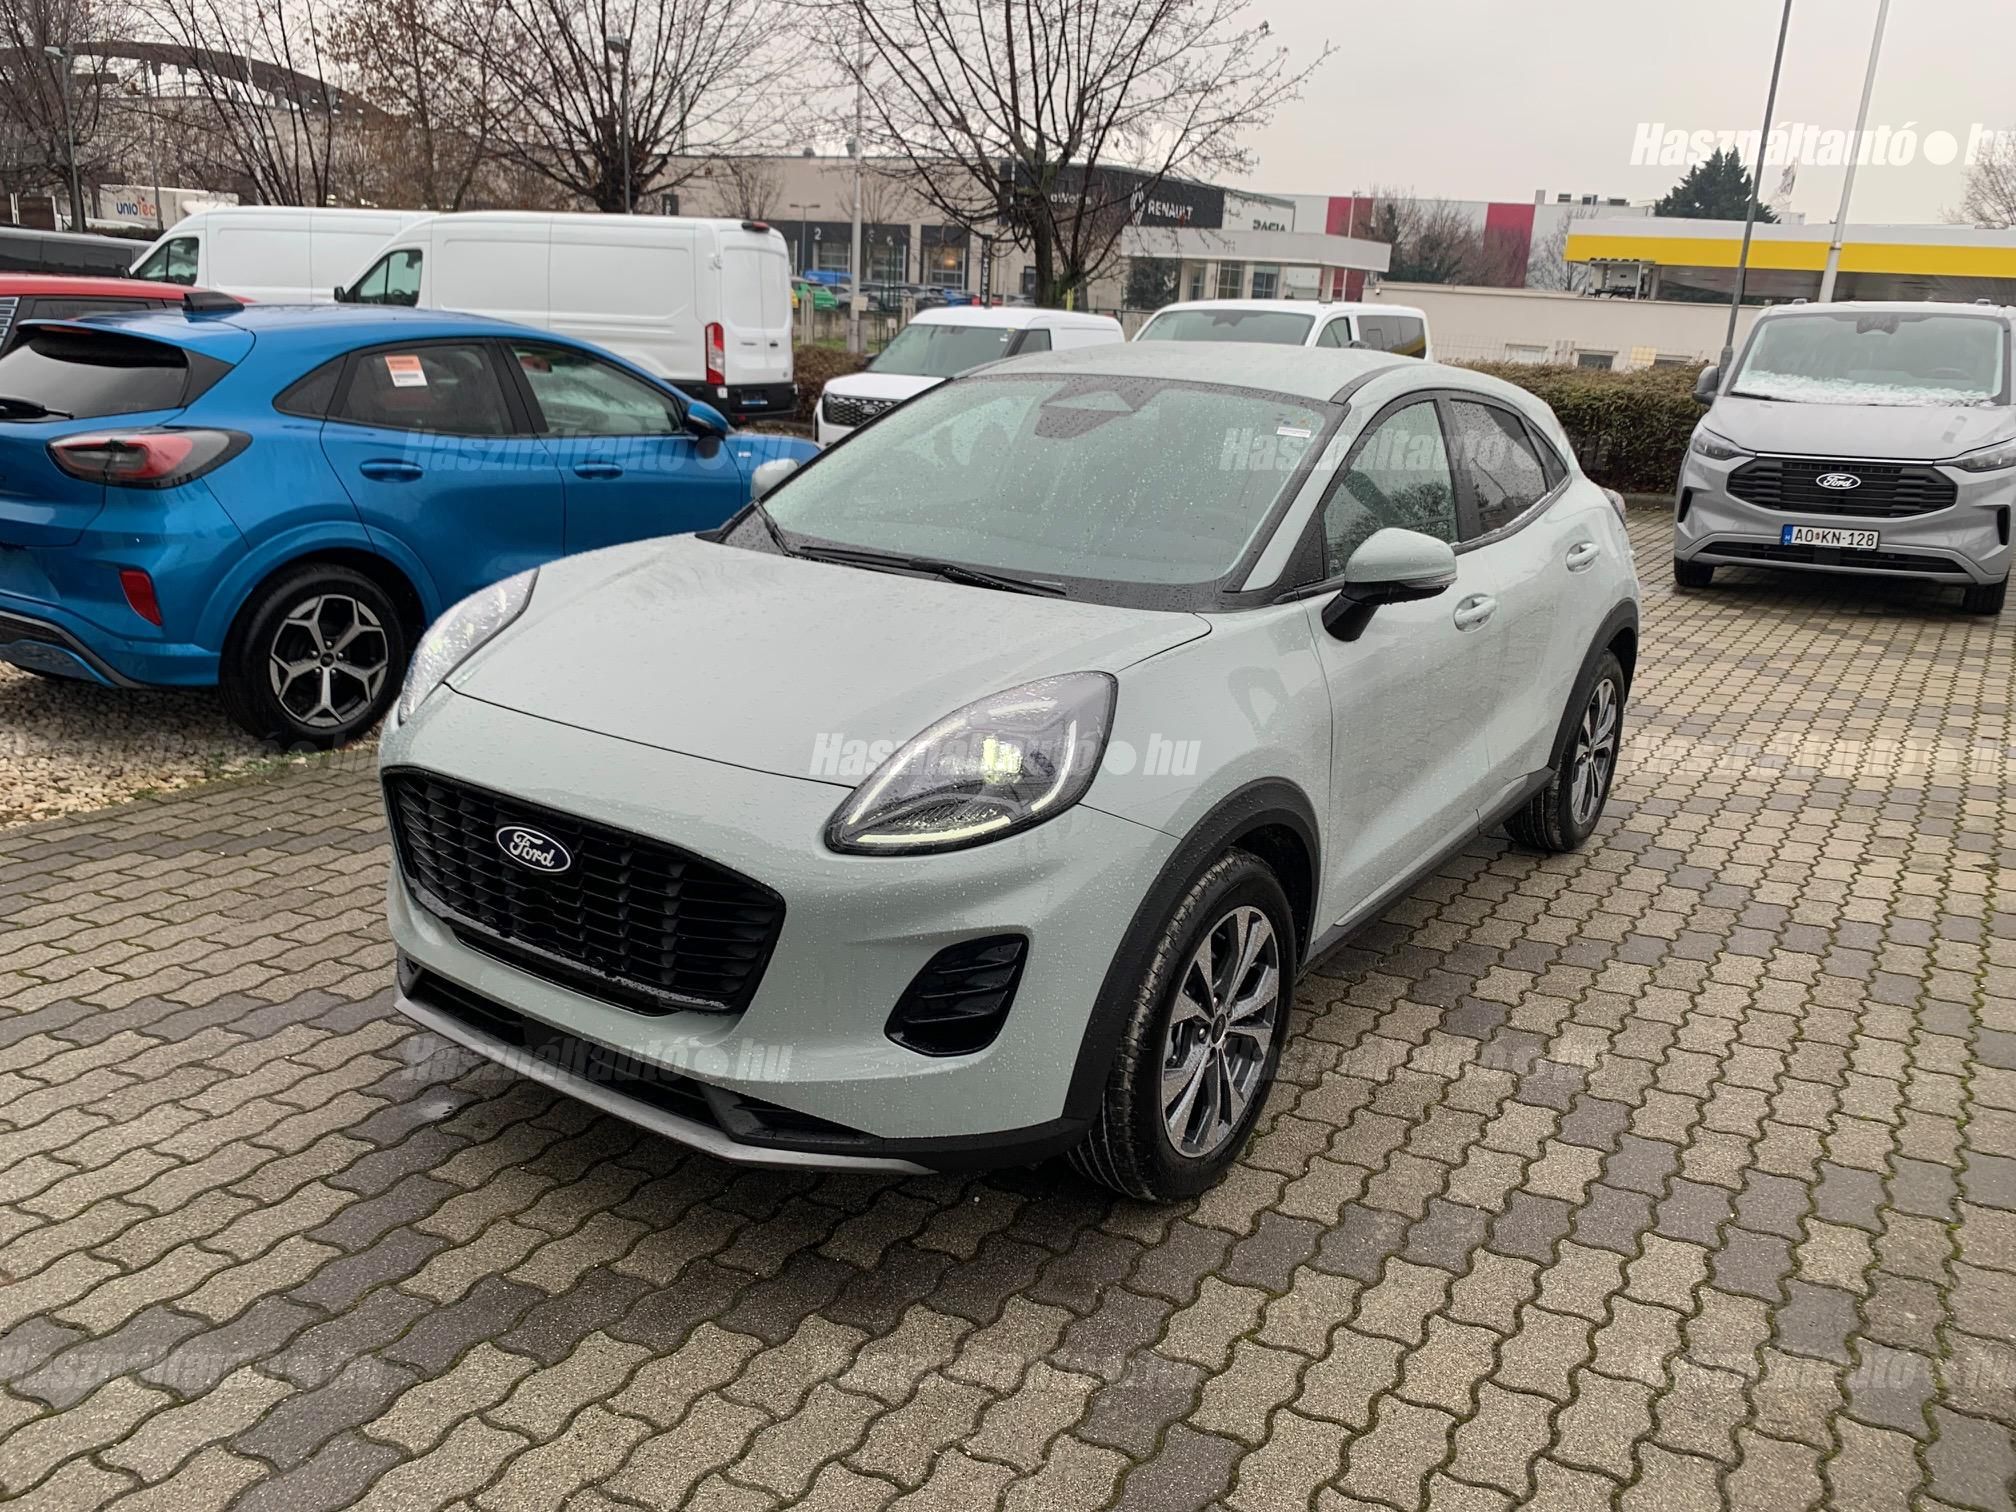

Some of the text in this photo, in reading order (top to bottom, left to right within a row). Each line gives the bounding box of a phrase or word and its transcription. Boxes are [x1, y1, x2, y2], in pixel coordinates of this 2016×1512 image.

[1147, 200, 1194, 221] RENAULT
[814, 227, 822, 241] 2
[1823, 475, 1854, 487] Ford
[1820, 530, 1875, 547] KN-128
[509, 831, 556, 868] Ford
